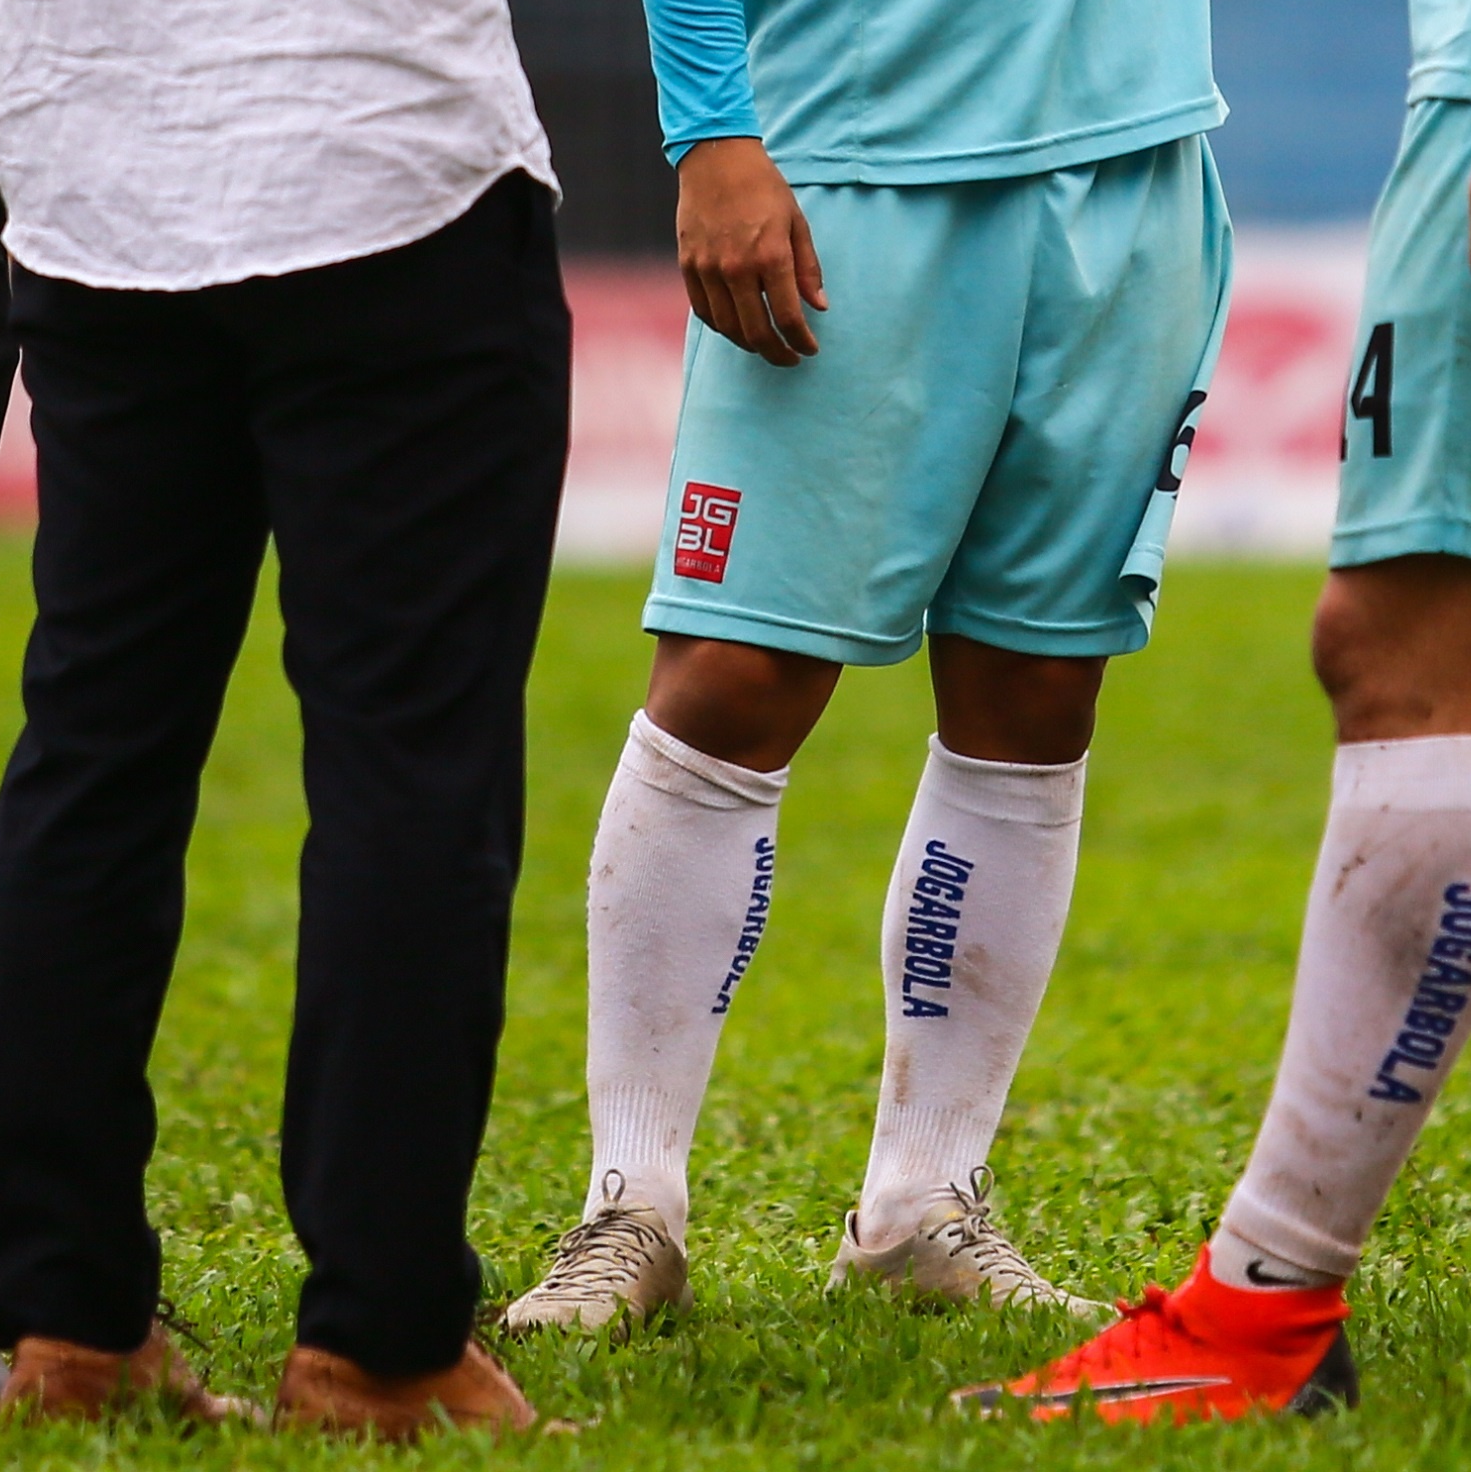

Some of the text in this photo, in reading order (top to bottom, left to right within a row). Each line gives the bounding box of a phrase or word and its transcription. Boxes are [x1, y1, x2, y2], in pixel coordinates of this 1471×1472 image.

[681, 493, 739, 526] JG
[677, 523, 724, 557] BL
[902, 839, 974, 1018] JOGARBOLA
